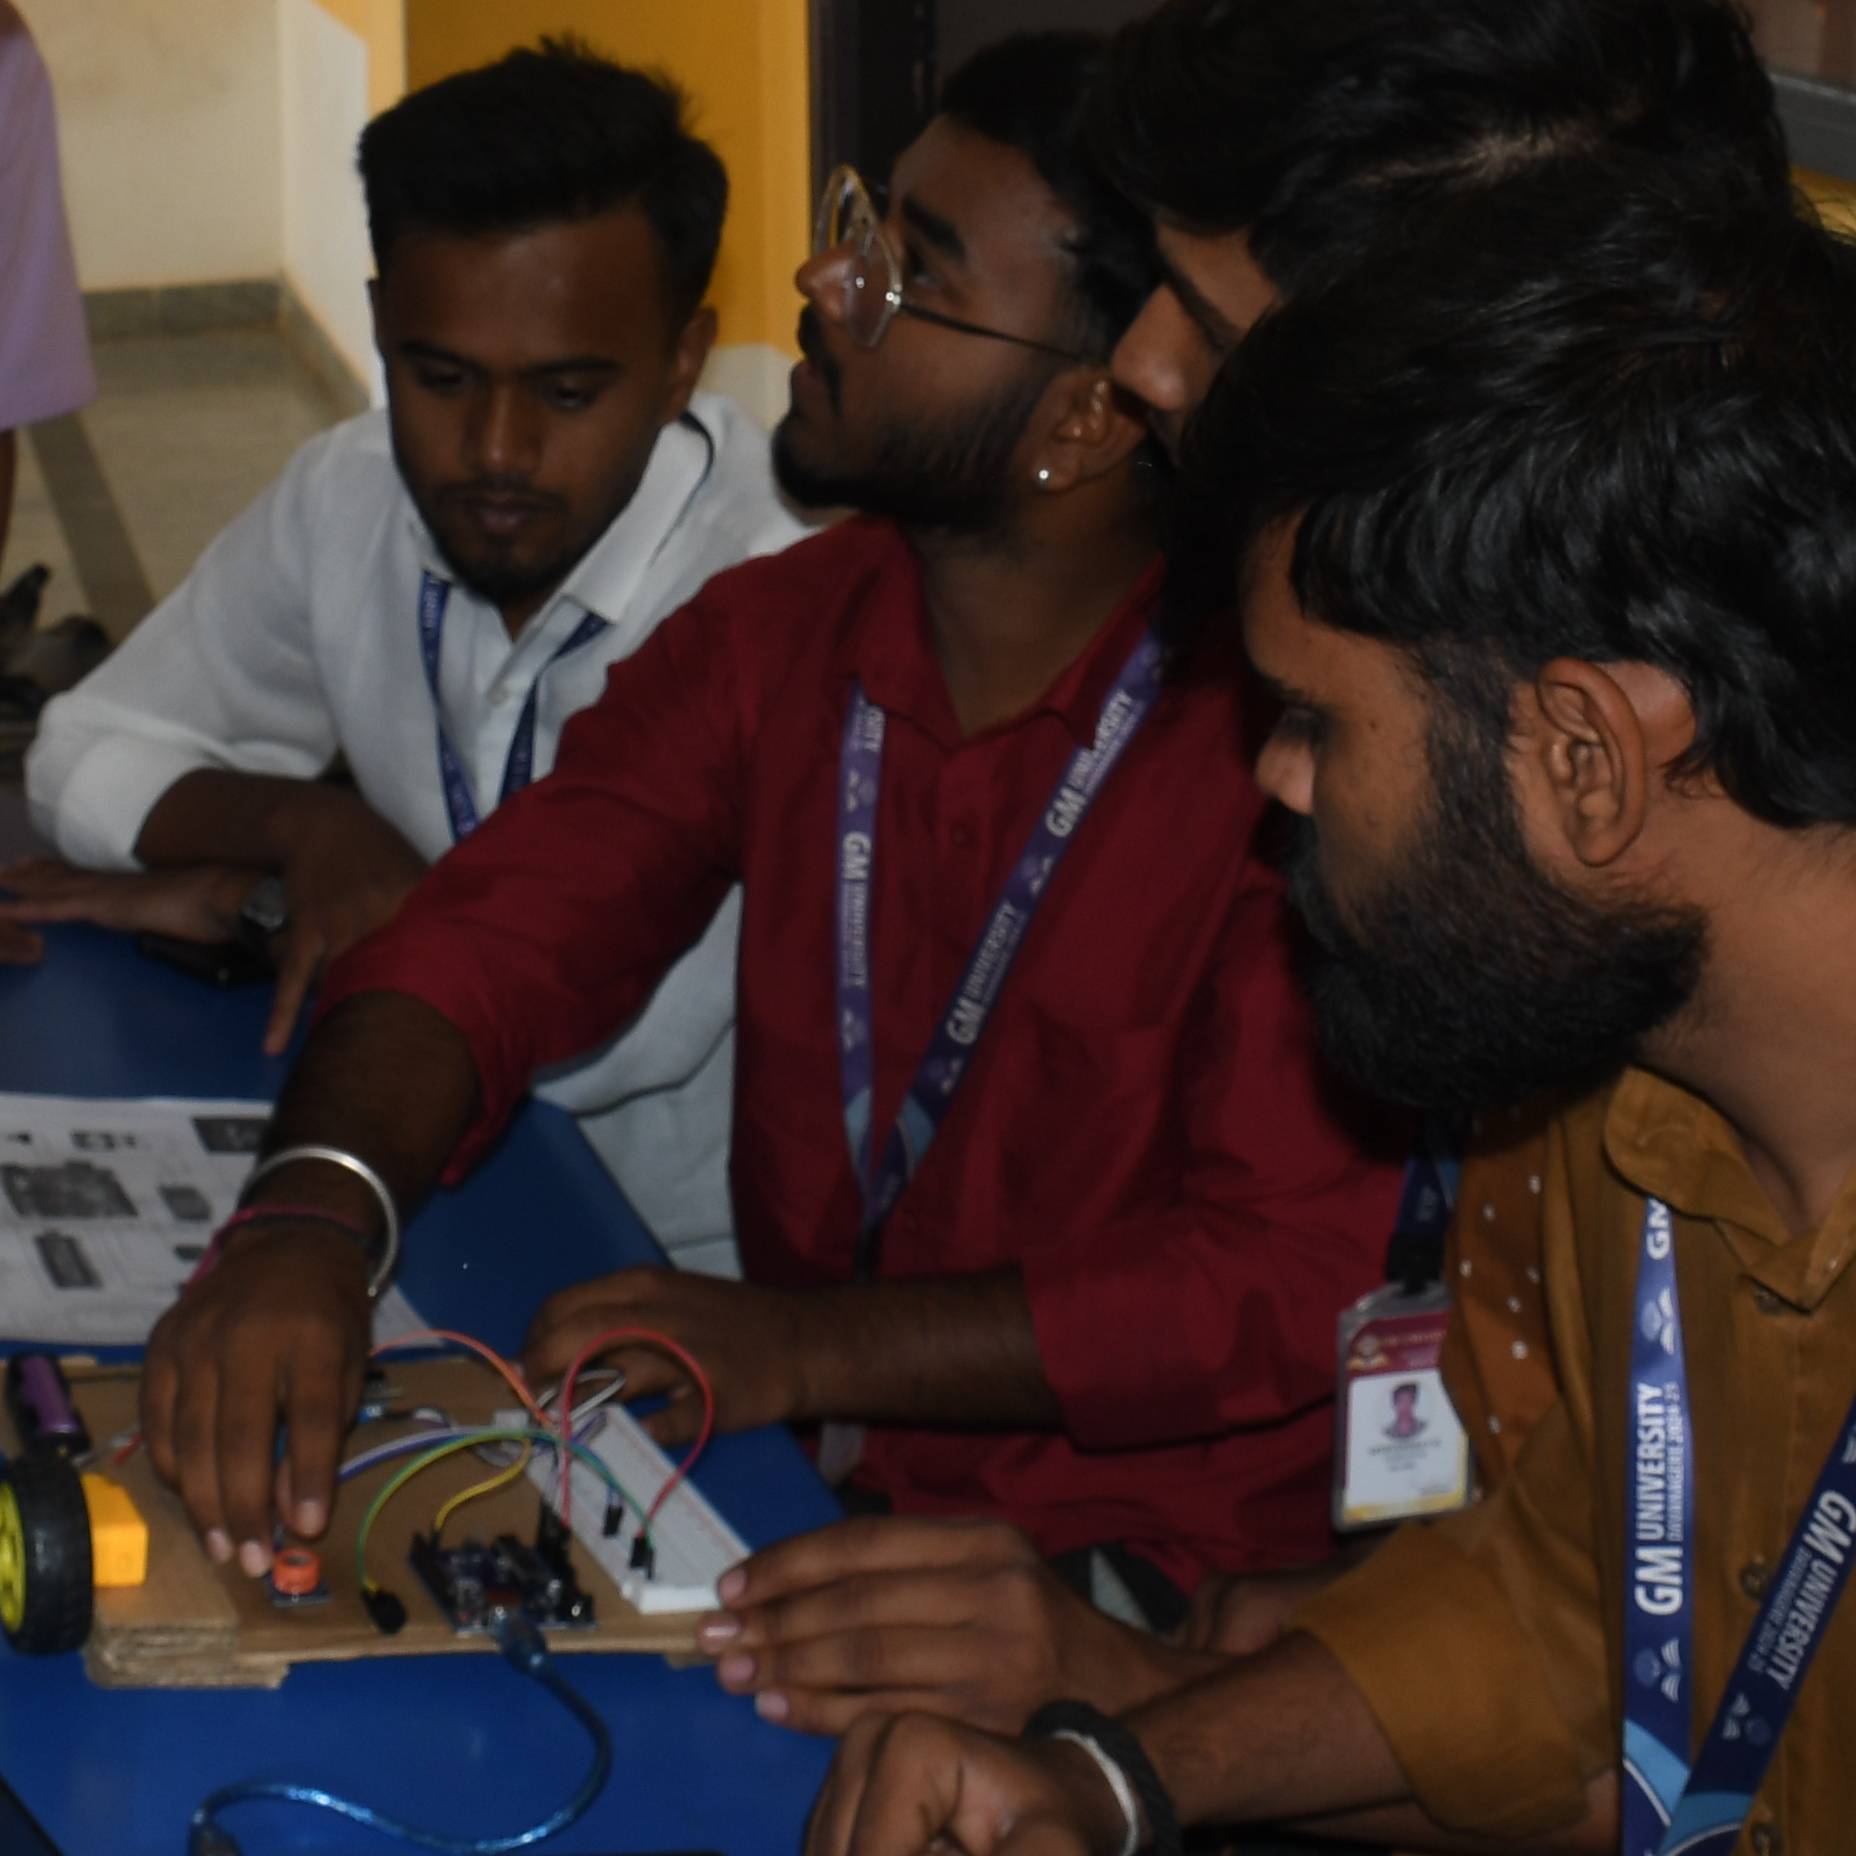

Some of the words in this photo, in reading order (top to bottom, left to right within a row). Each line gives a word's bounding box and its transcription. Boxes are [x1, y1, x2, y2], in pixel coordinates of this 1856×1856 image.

[1045, 786, 1089, 838] GM
[842, 830, 872, 880] GM
[945, 996, 986, 1046] GM
[1635, 1381, 1668, 1543] UNIVERSITY
[1633, 1544, 1685, 1618] GM
[1765, 1557, 1839, 1691] UNIVERSITY
